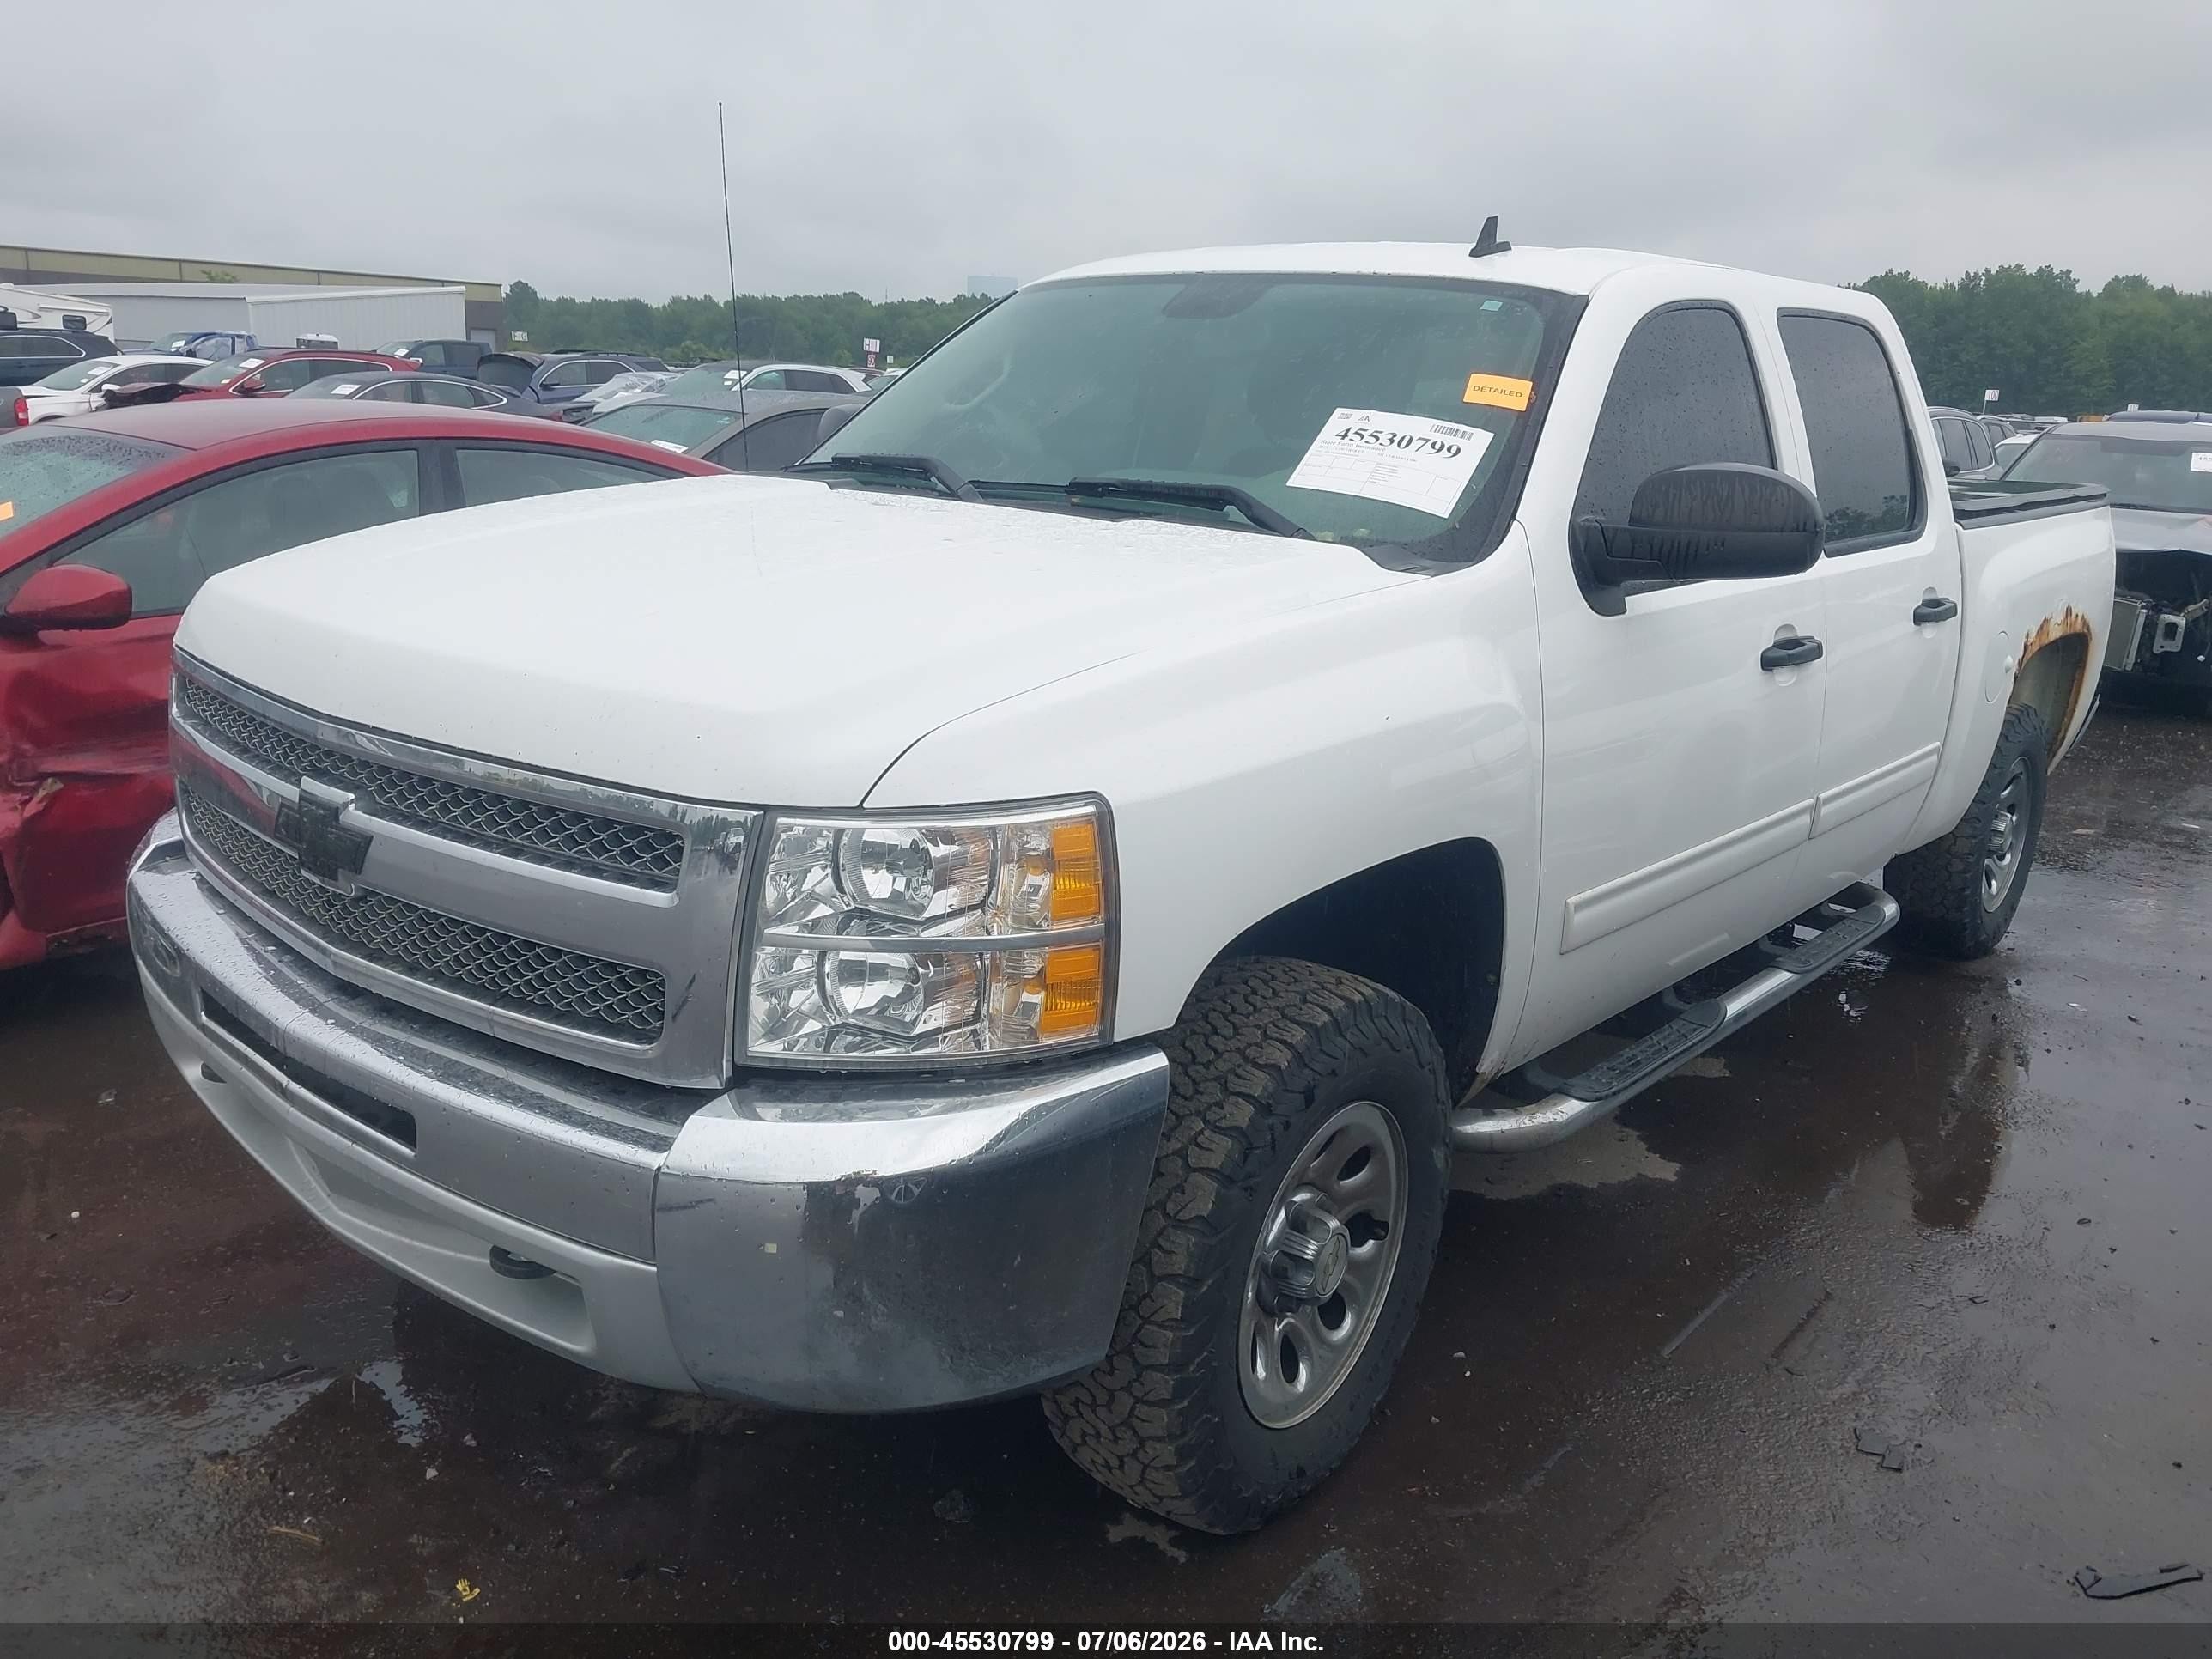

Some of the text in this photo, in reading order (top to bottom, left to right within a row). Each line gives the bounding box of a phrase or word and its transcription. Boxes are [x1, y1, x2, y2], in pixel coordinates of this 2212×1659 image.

[1472, 386, 1522, 398] DETAILED
[1334, 427, 1462, 459] 45530799
[1355, 442, 1387, 453] Insurance
